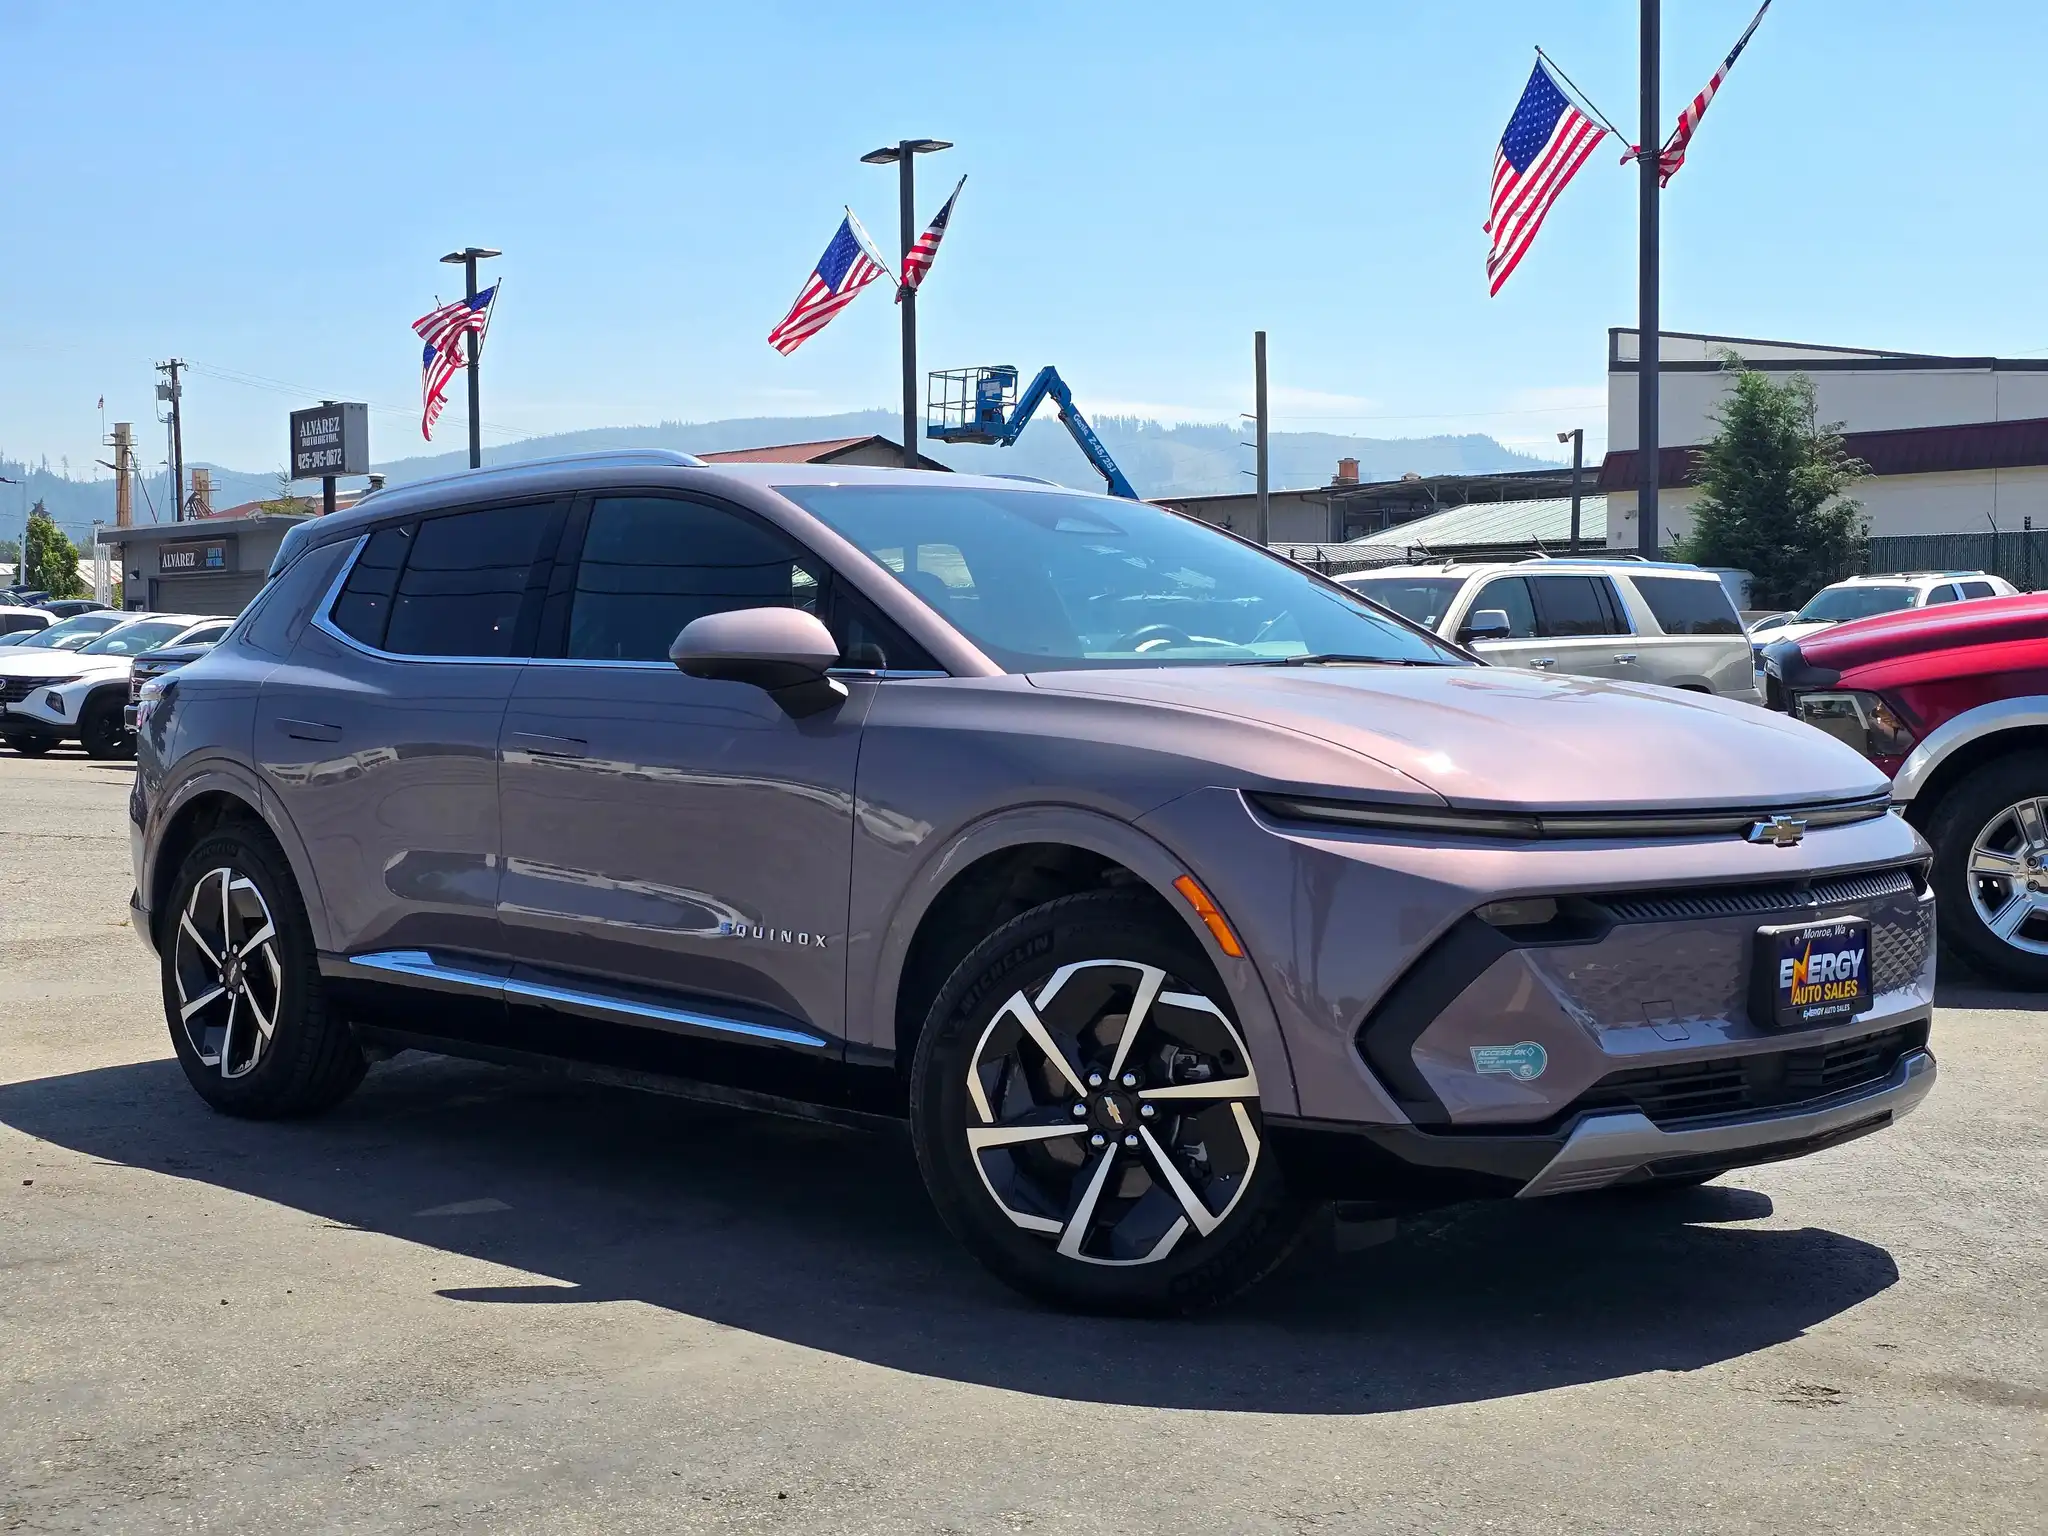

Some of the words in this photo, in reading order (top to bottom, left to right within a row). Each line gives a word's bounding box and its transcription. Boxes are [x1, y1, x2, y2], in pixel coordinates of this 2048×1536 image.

[300, 416, 340, 437] ALVAREZ
[162, 552, 195, 568] ALVAREZ
[720, 921, 826, 948] EQUINOX
[1803, 928, 1833, 940] Monroe,
[1834, 924, 1846, 936] Wa
[960, 933, 1049, 1015] MICHELIN
[1780, 941, 1864, 992] ENERGY
[1792, 985, 1822, 1006] AUTO
[1824, 980, 1858, 1000] SALES
[1837, 1003, 1850, 1012] SALES
